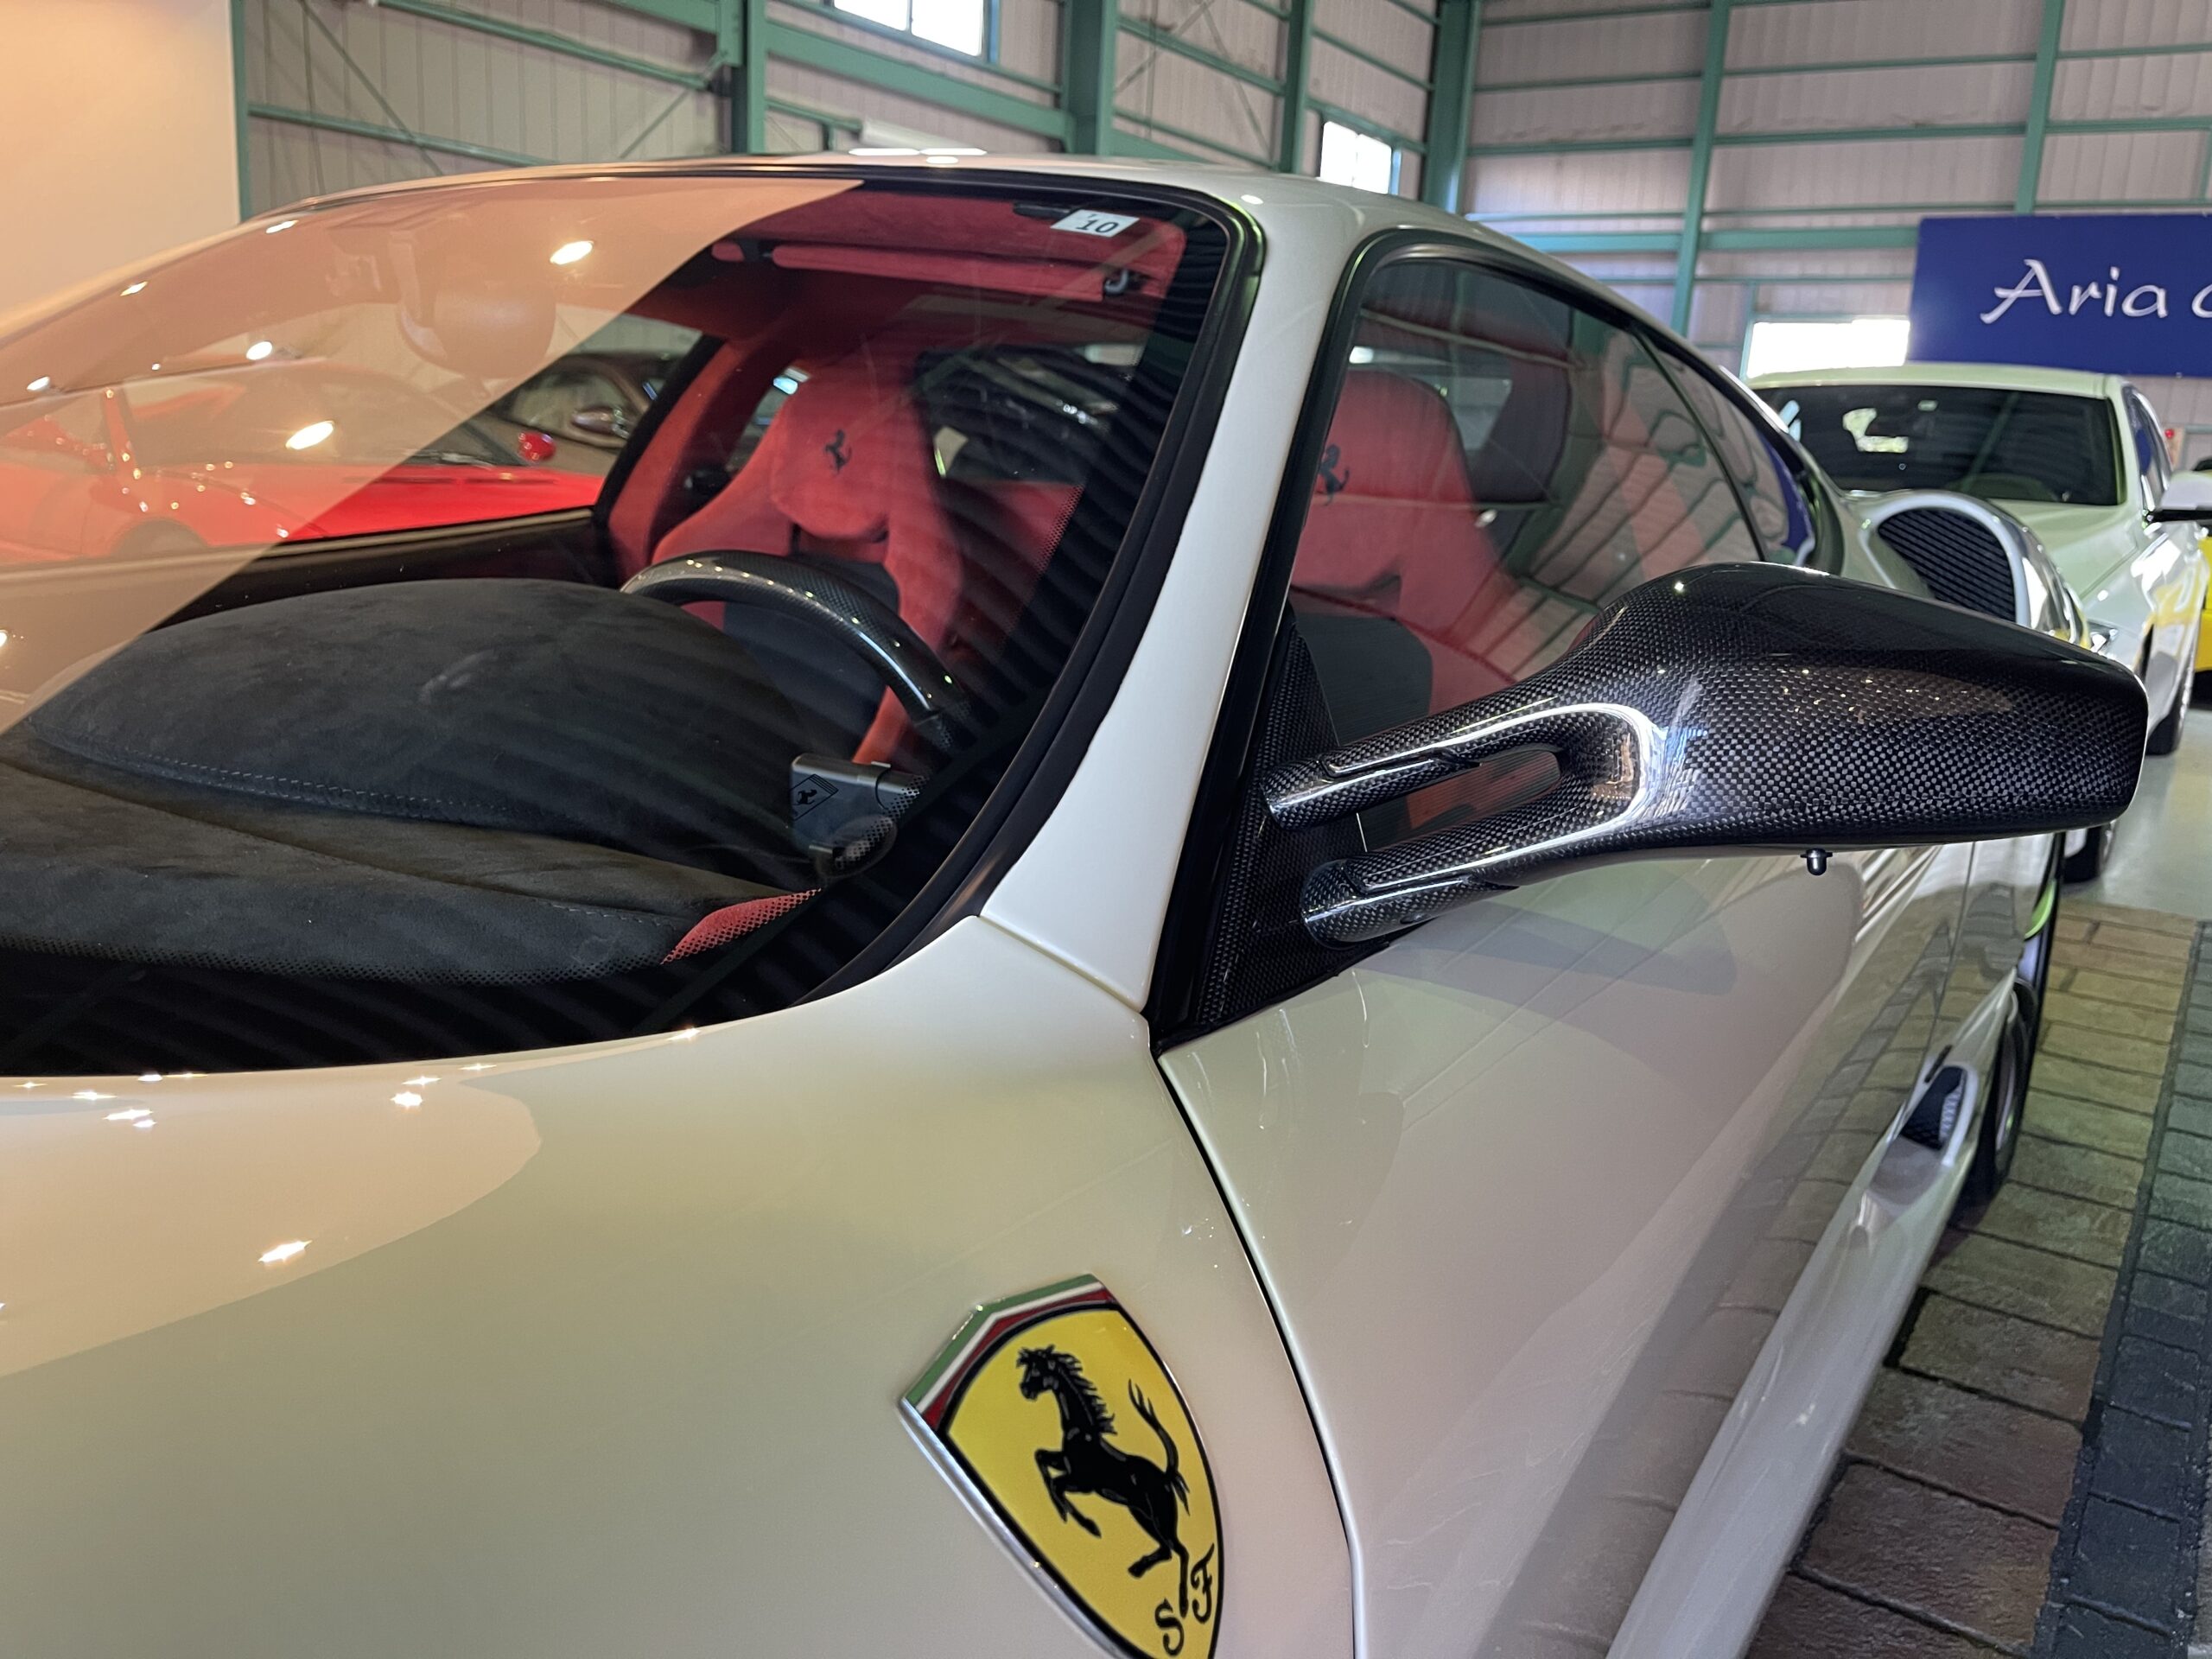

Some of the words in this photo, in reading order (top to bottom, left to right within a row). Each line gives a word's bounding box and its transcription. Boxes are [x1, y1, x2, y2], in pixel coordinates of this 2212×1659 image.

[1980, 259, 2169, 324] Aria
[1154, 1598, 1185, 1657] S
[1190, 1542, 1215, 1624] F
